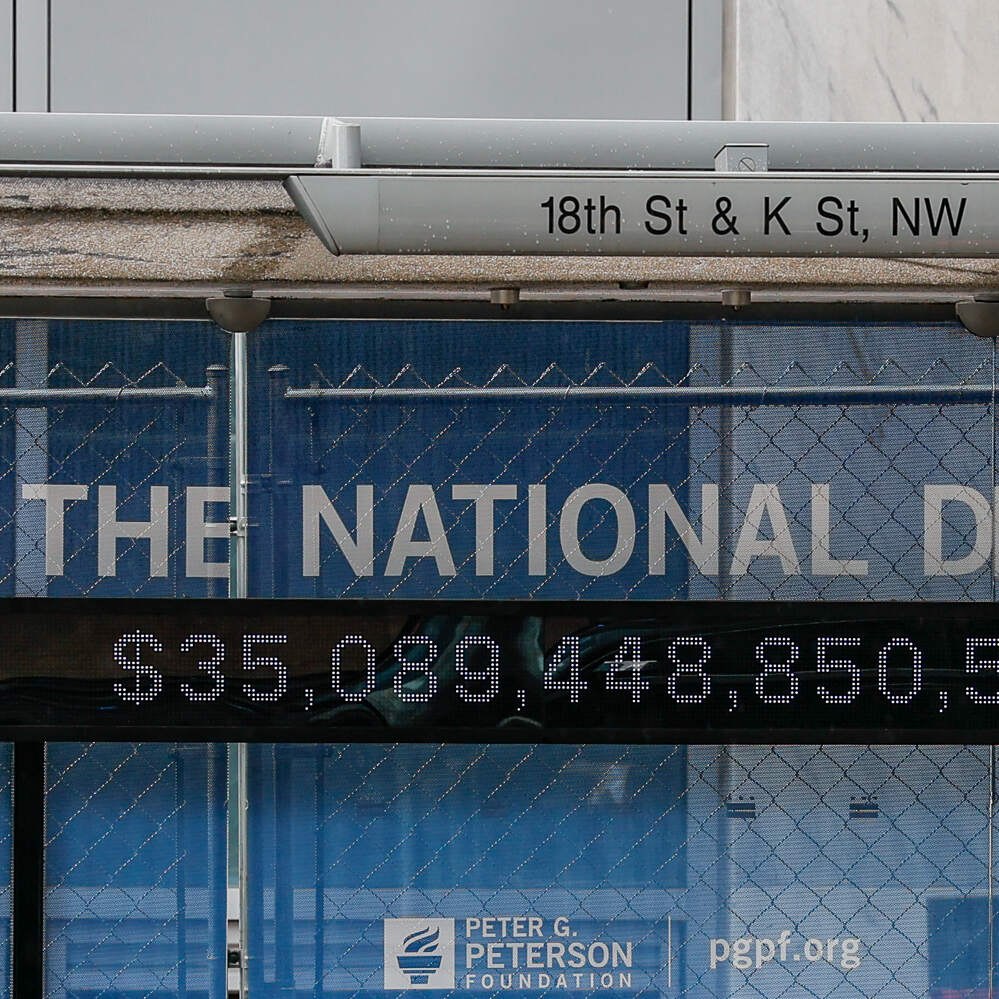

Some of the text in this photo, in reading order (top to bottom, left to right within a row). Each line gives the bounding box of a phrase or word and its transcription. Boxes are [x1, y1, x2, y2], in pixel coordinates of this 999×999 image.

[540, 195, 967, 240] 18th St & K St, NW
[22, 484, 231, 578] THE
[302, 484, 868, 578] NATIONAL
[466, 917, 578, 938] PETER G.
[466, 942, 633, 969] PETERSON
[709, 928, 862, 970] pgpf.org
[466, 973, 633, 989] FOUNDATION
